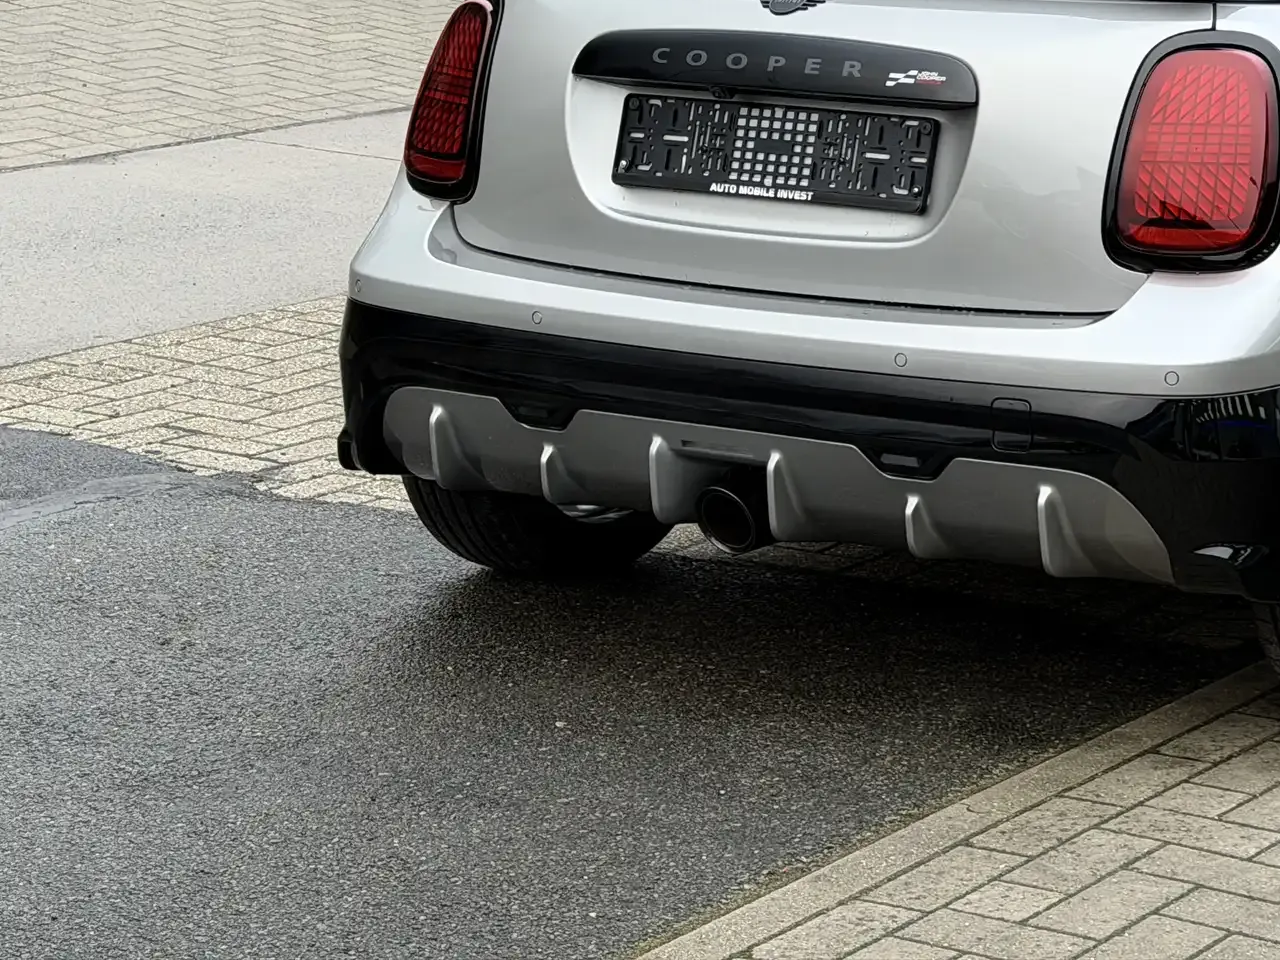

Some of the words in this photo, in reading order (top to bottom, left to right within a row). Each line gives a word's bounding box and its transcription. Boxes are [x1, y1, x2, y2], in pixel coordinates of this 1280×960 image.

[652, 47, 862, 78] COOPER
[709, 182, 737, 194] AUTO
[738, 185, 775, 198] MOBILE
[776, 189, 814, 201] INVEST
